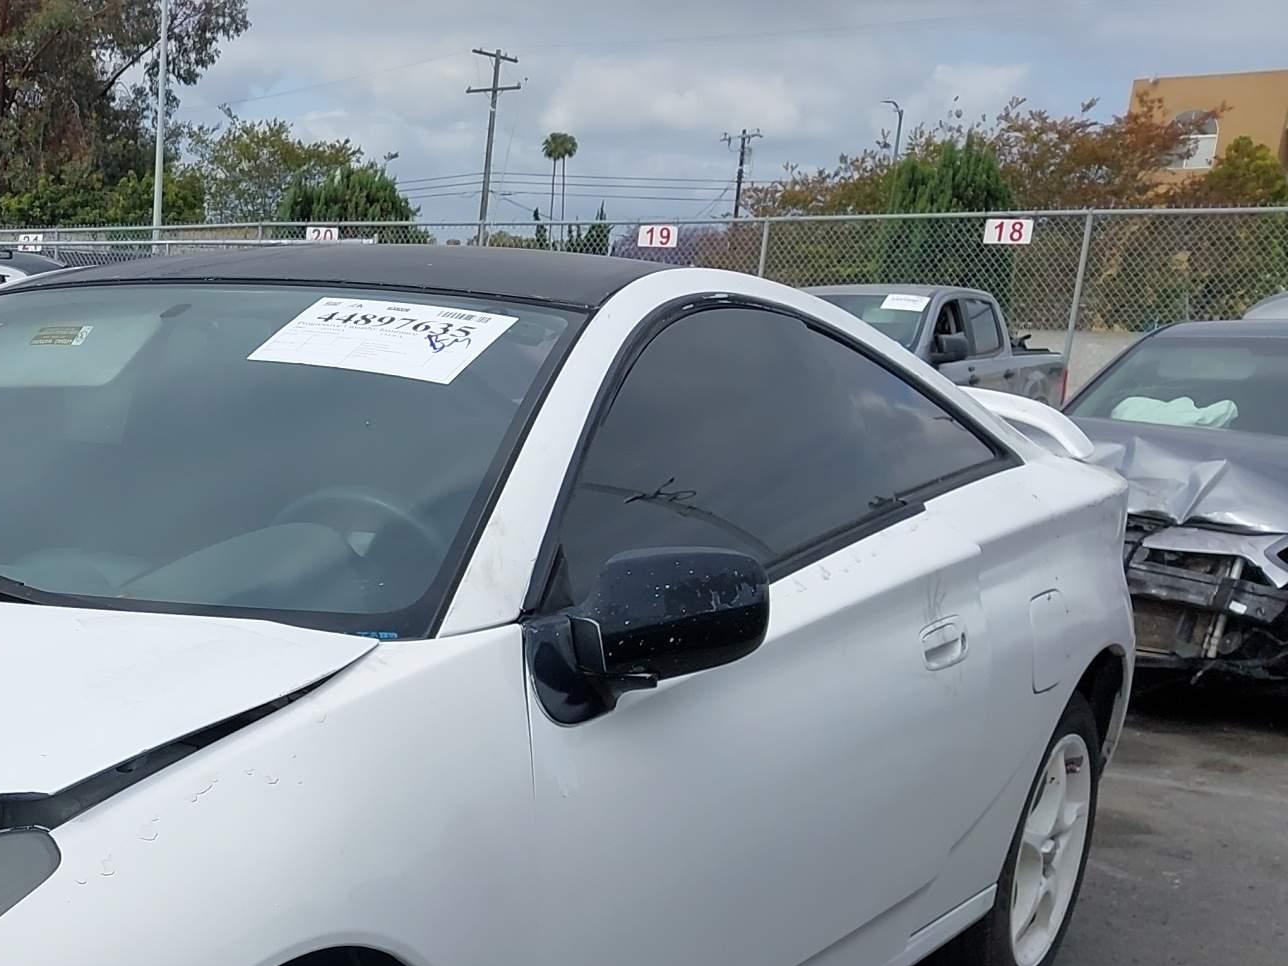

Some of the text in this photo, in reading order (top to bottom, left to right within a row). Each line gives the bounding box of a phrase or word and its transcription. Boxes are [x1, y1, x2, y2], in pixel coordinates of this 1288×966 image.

[311, 229, 333, 241] 20
[646, 227, 671, 246] 19
[994, 221, 1024, 242] 18
[317, 311, 477, 338] 44897635
